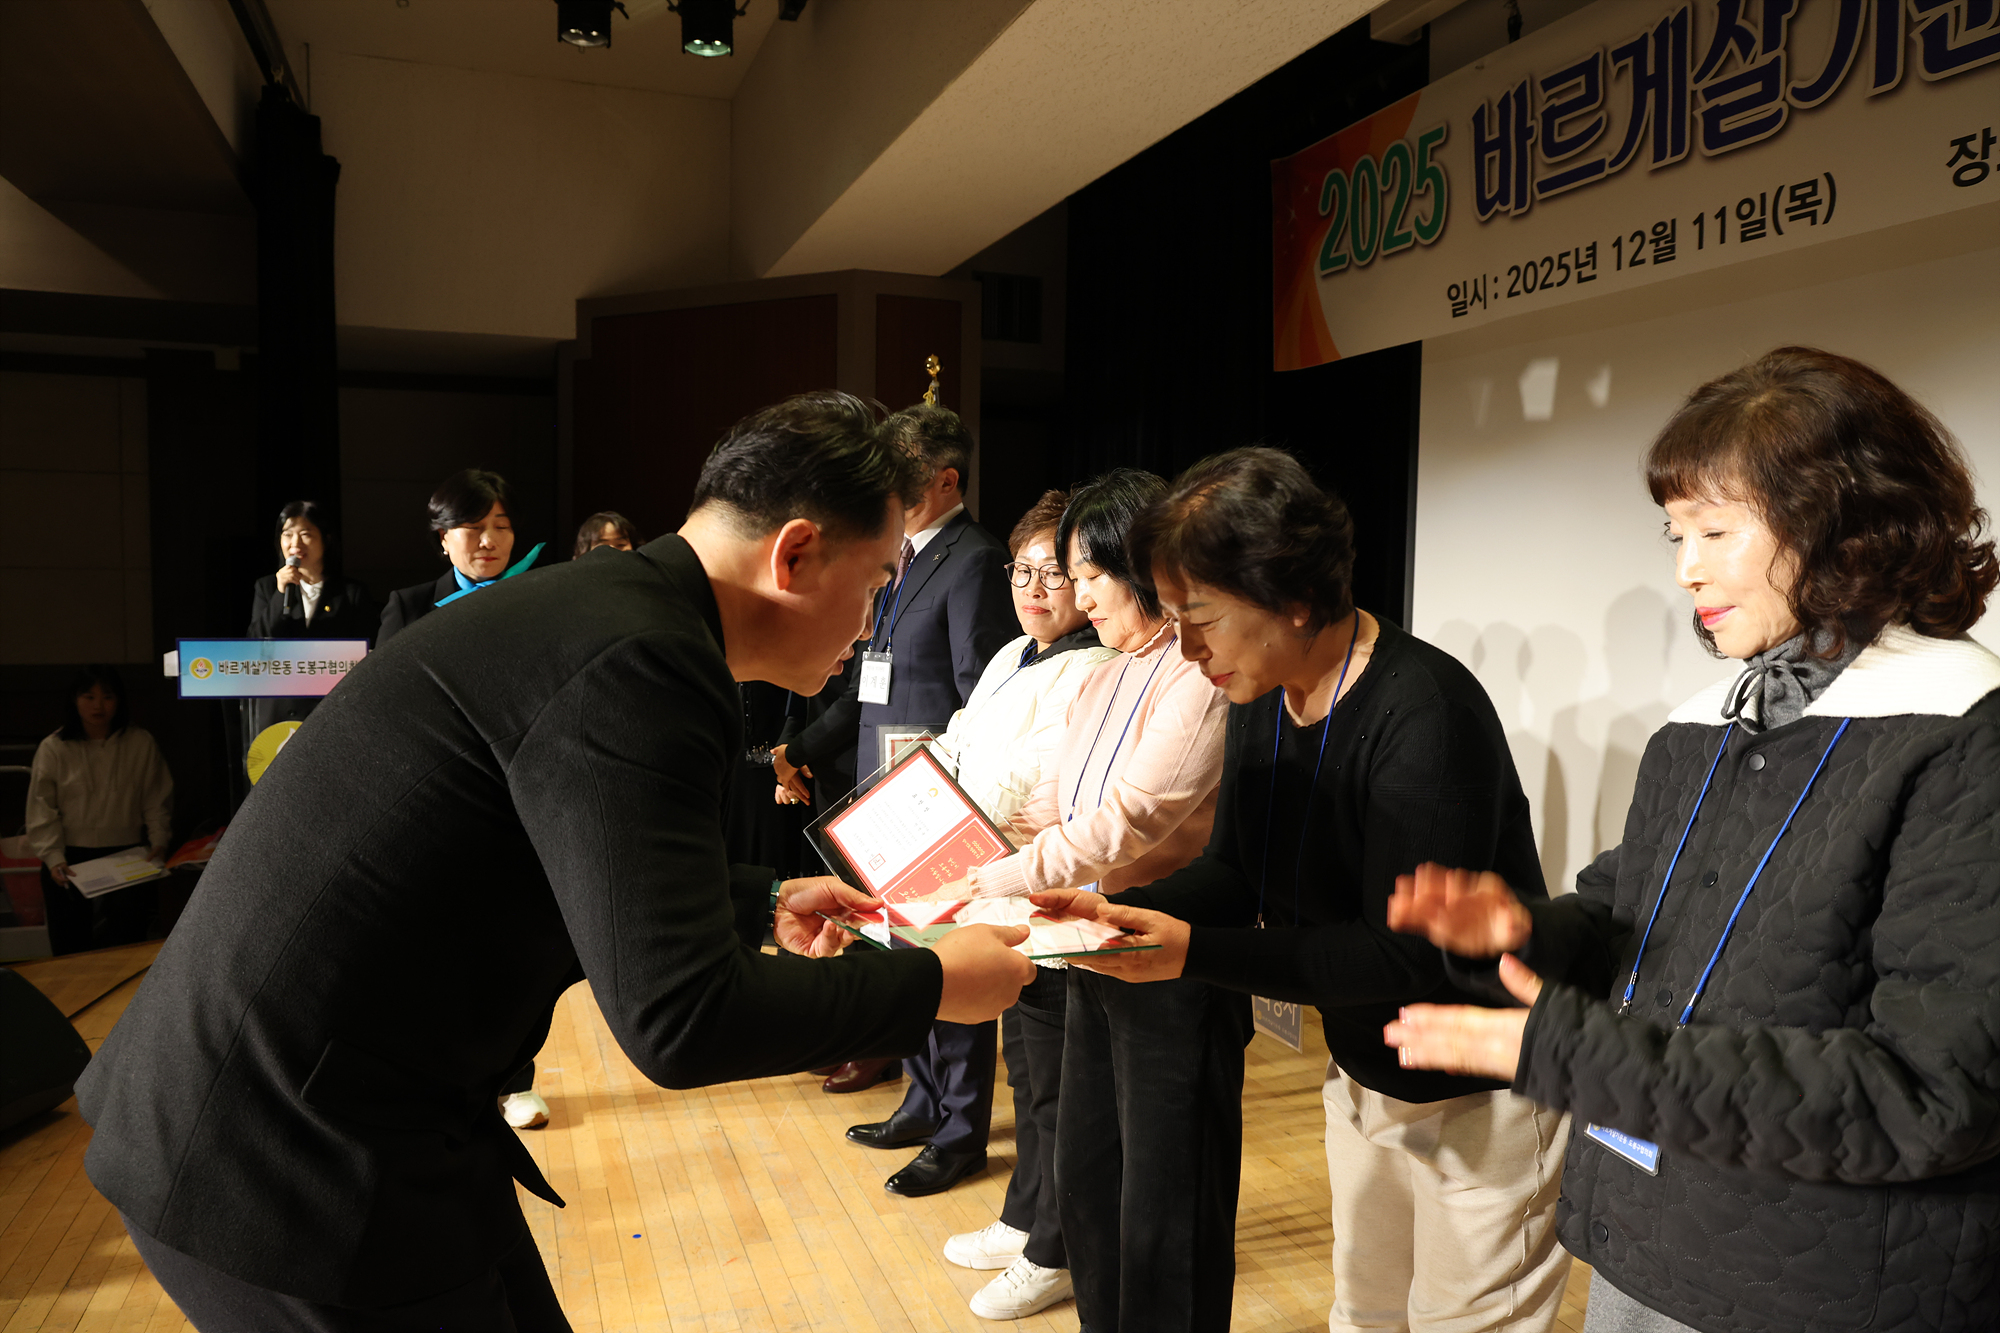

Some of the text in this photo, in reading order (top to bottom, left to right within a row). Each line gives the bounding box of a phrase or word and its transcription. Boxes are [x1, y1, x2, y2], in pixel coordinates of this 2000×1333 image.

[1317, 123, 1447, 274] 2025
[1506, 240, 1599, 299] 2025년
[1611, 217, 1678, 272] 12월
[1692, 171, 1838, 251] 11일(목)
[1945, 126, 2000, 188] 장
[217, 660, 292, 675] 바르게살기운동
